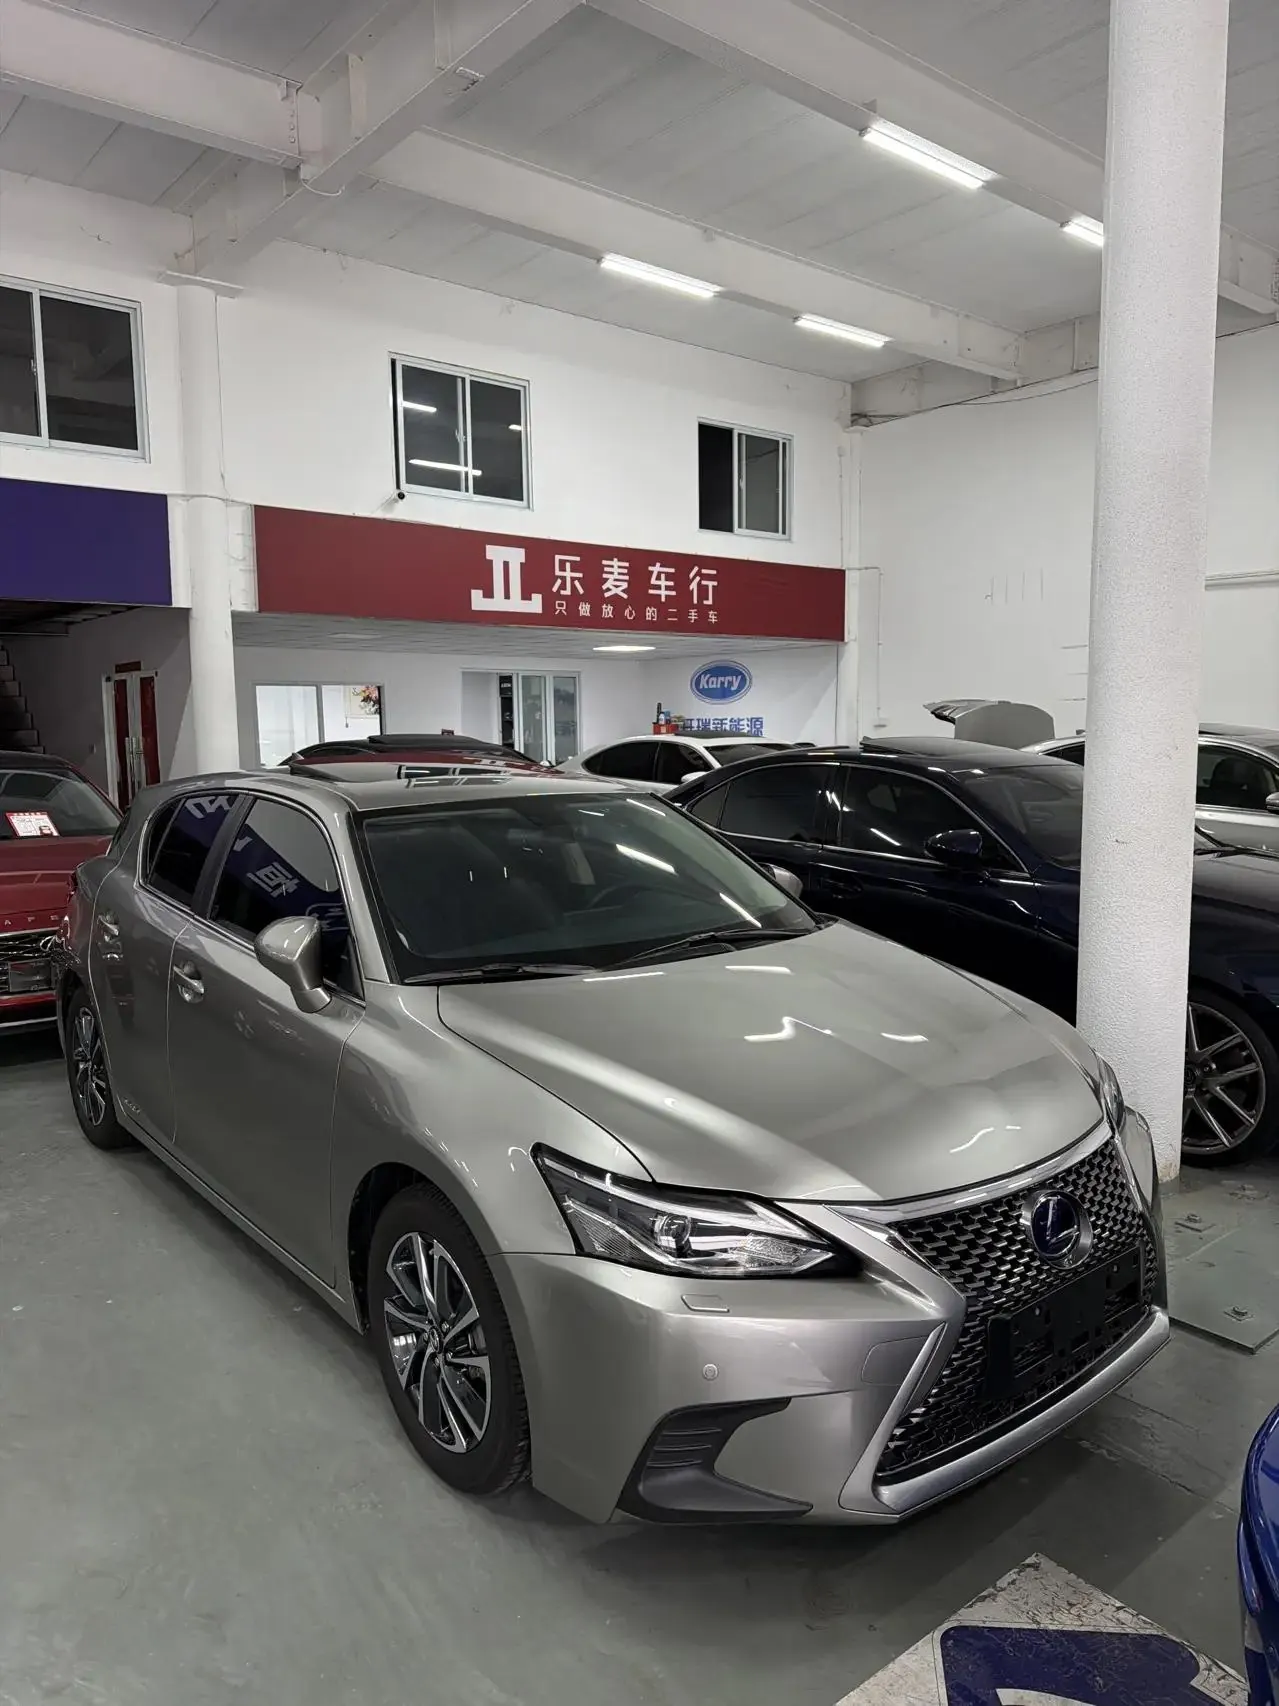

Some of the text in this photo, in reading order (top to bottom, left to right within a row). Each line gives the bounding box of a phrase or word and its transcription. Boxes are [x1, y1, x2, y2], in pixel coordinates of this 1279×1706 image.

[552, 554, 718, 605] 乐麦车行
[554, 600, 718, 624] 只做放心的二手车
[700, 673, 742, 691] Karry
